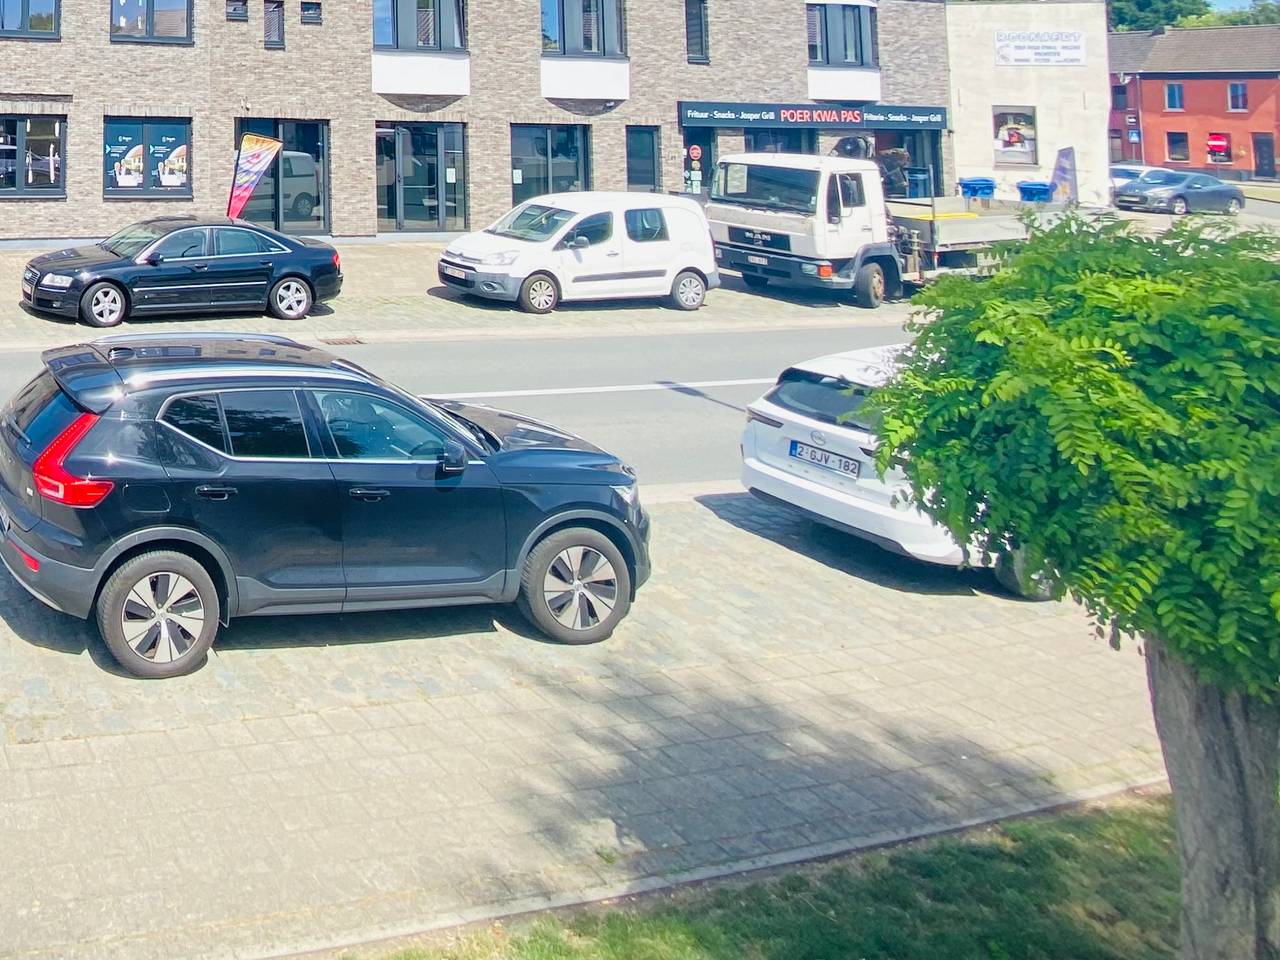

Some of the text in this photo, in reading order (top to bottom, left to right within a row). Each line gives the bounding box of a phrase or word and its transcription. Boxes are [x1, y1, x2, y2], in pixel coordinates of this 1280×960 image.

[687, 109, 708, 119] Frituur
[713, 110, 735, 119] Snacks
[740, 111, 760, 122] Josper
[761, 111, 776, 120] Grill
[780, 109, 861, 123] POER KWA PAS
[888, 113, 907, 121] Snacks
[929, 114, 942, 122] Grill
[745, 231, 771, 241] MAN
